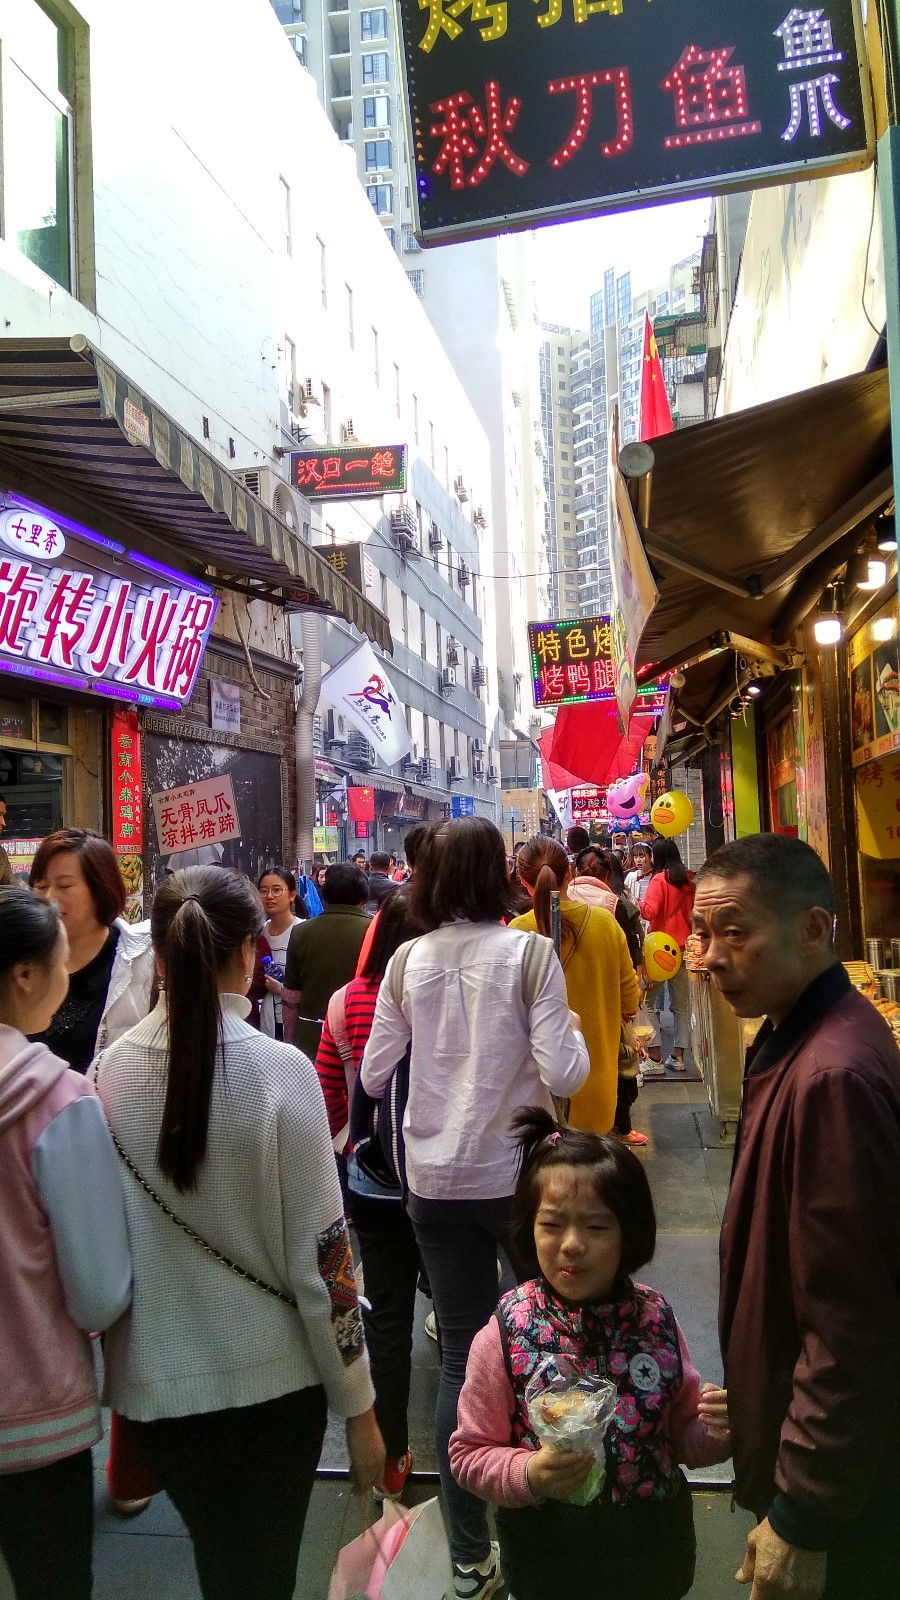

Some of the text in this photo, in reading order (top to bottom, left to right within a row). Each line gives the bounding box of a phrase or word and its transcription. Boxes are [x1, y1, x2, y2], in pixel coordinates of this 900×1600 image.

[772, 8, 851, 142] 鱼爪
[430, 45, 761, 191] 秋刀鱼
[297, 450, 395, 484] 汉口一绝
[11, 518, 58, 554] 七里香
[0, 561, 212, 695] 旋转小火锅
[540, 659, 615, 698] 烤鸭腿
[161, 792, 231, 828] 无骨凤爪
[161, 812, 235, 848] 凉拌猪蹄
